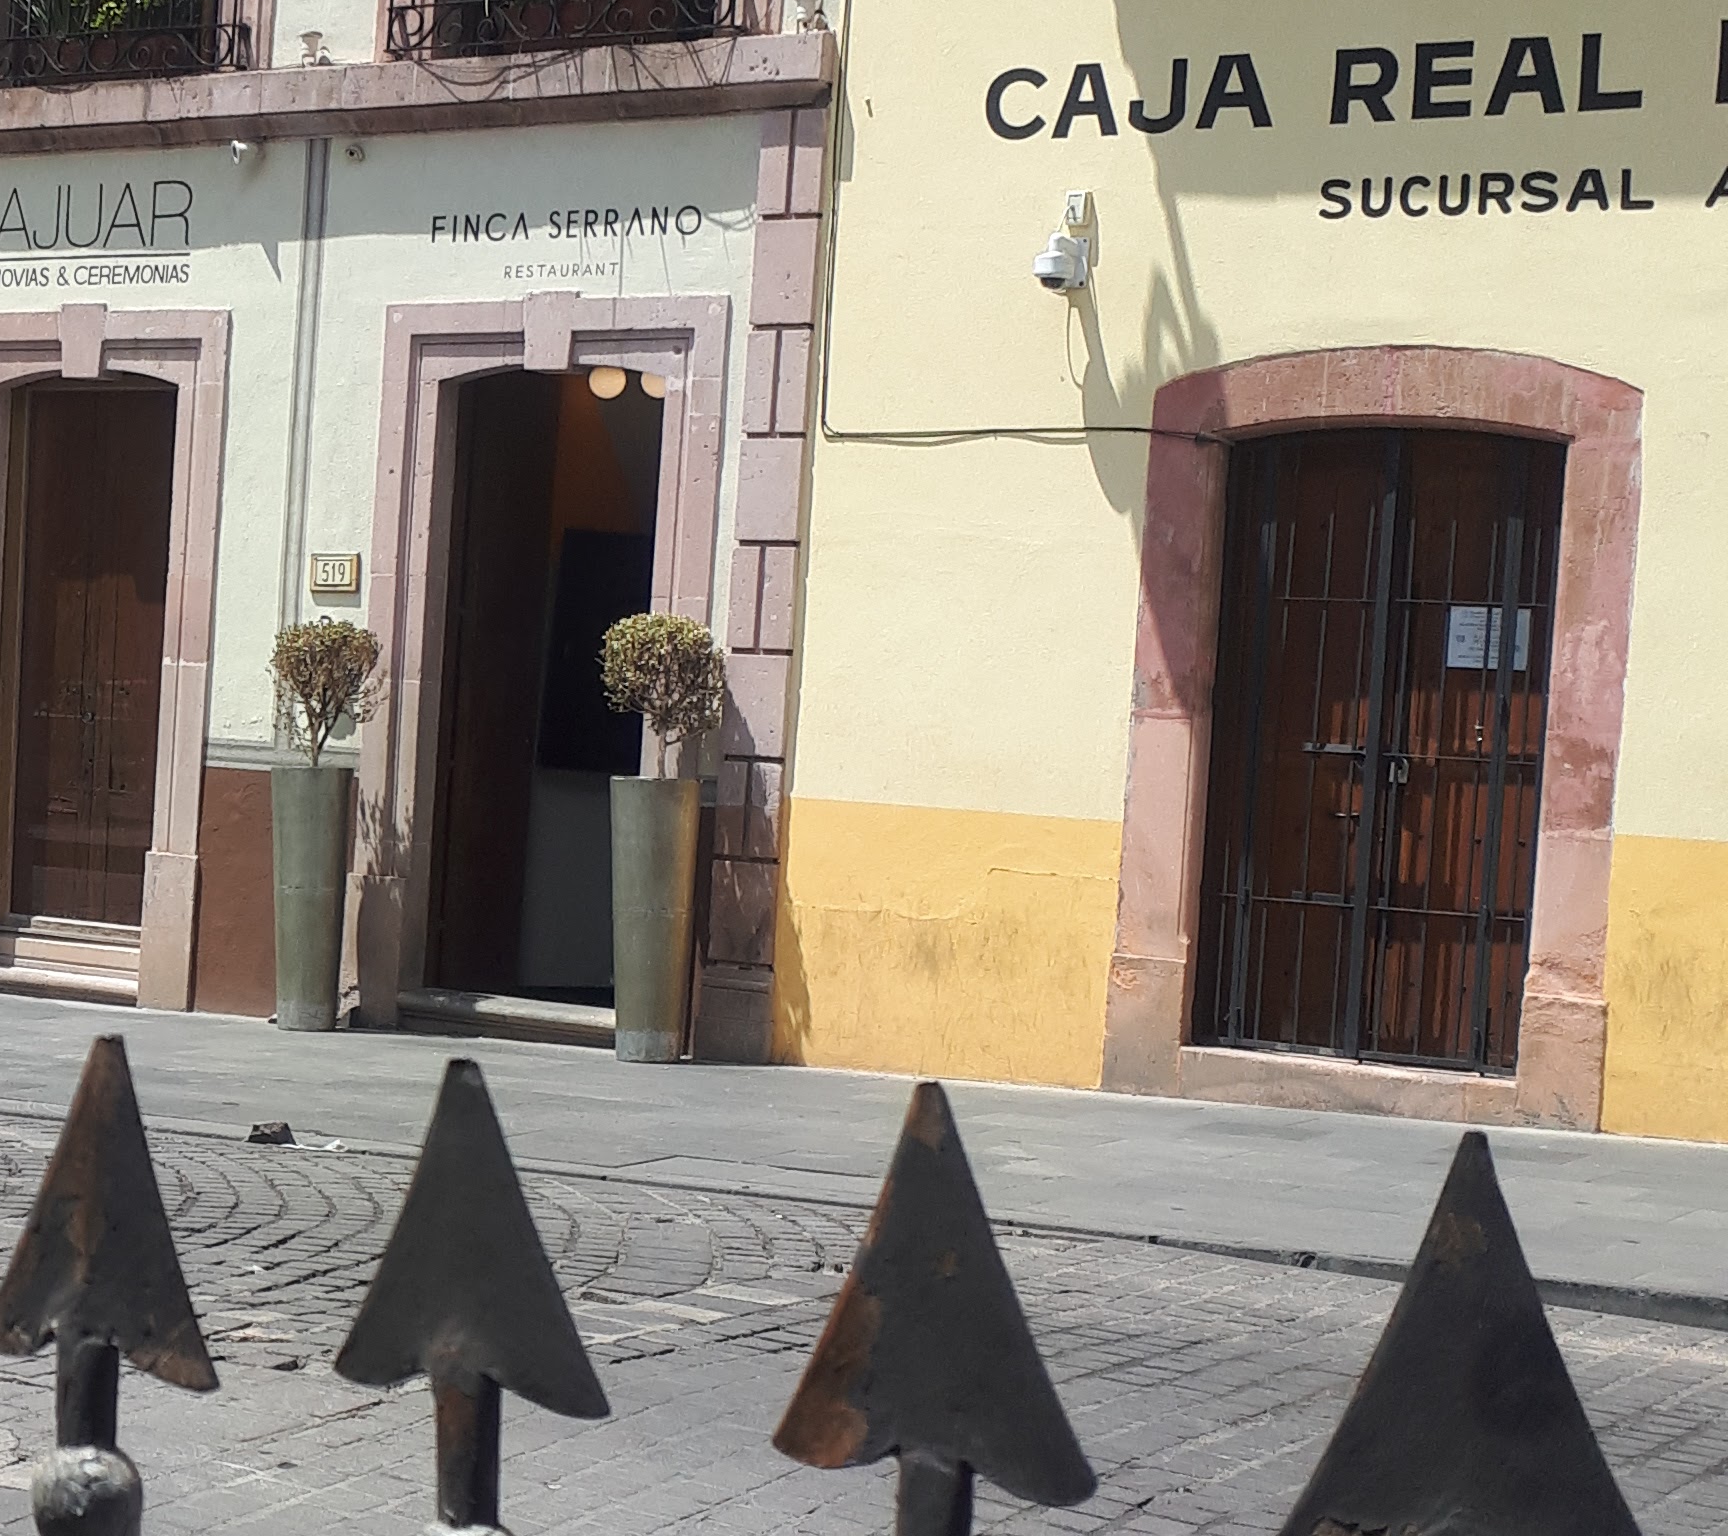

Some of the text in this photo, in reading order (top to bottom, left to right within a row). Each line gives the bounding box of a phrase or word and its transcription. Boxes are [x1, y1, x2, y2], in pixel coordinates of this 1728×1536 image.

[985, 53, 1273, 140] CAJA
[1329, 32, 1643, 125] REAL
[1319, 168, 1655, 220] SUCURSAL
[431, 205, 702, 244] FINCA SERRANO
[56, 265, 70, 287] &
[73, 263, 190, 286] CEREMONIAS
[503, 262, 619, 280] RESTAURANT
[322, 562, 345, 583] 519
